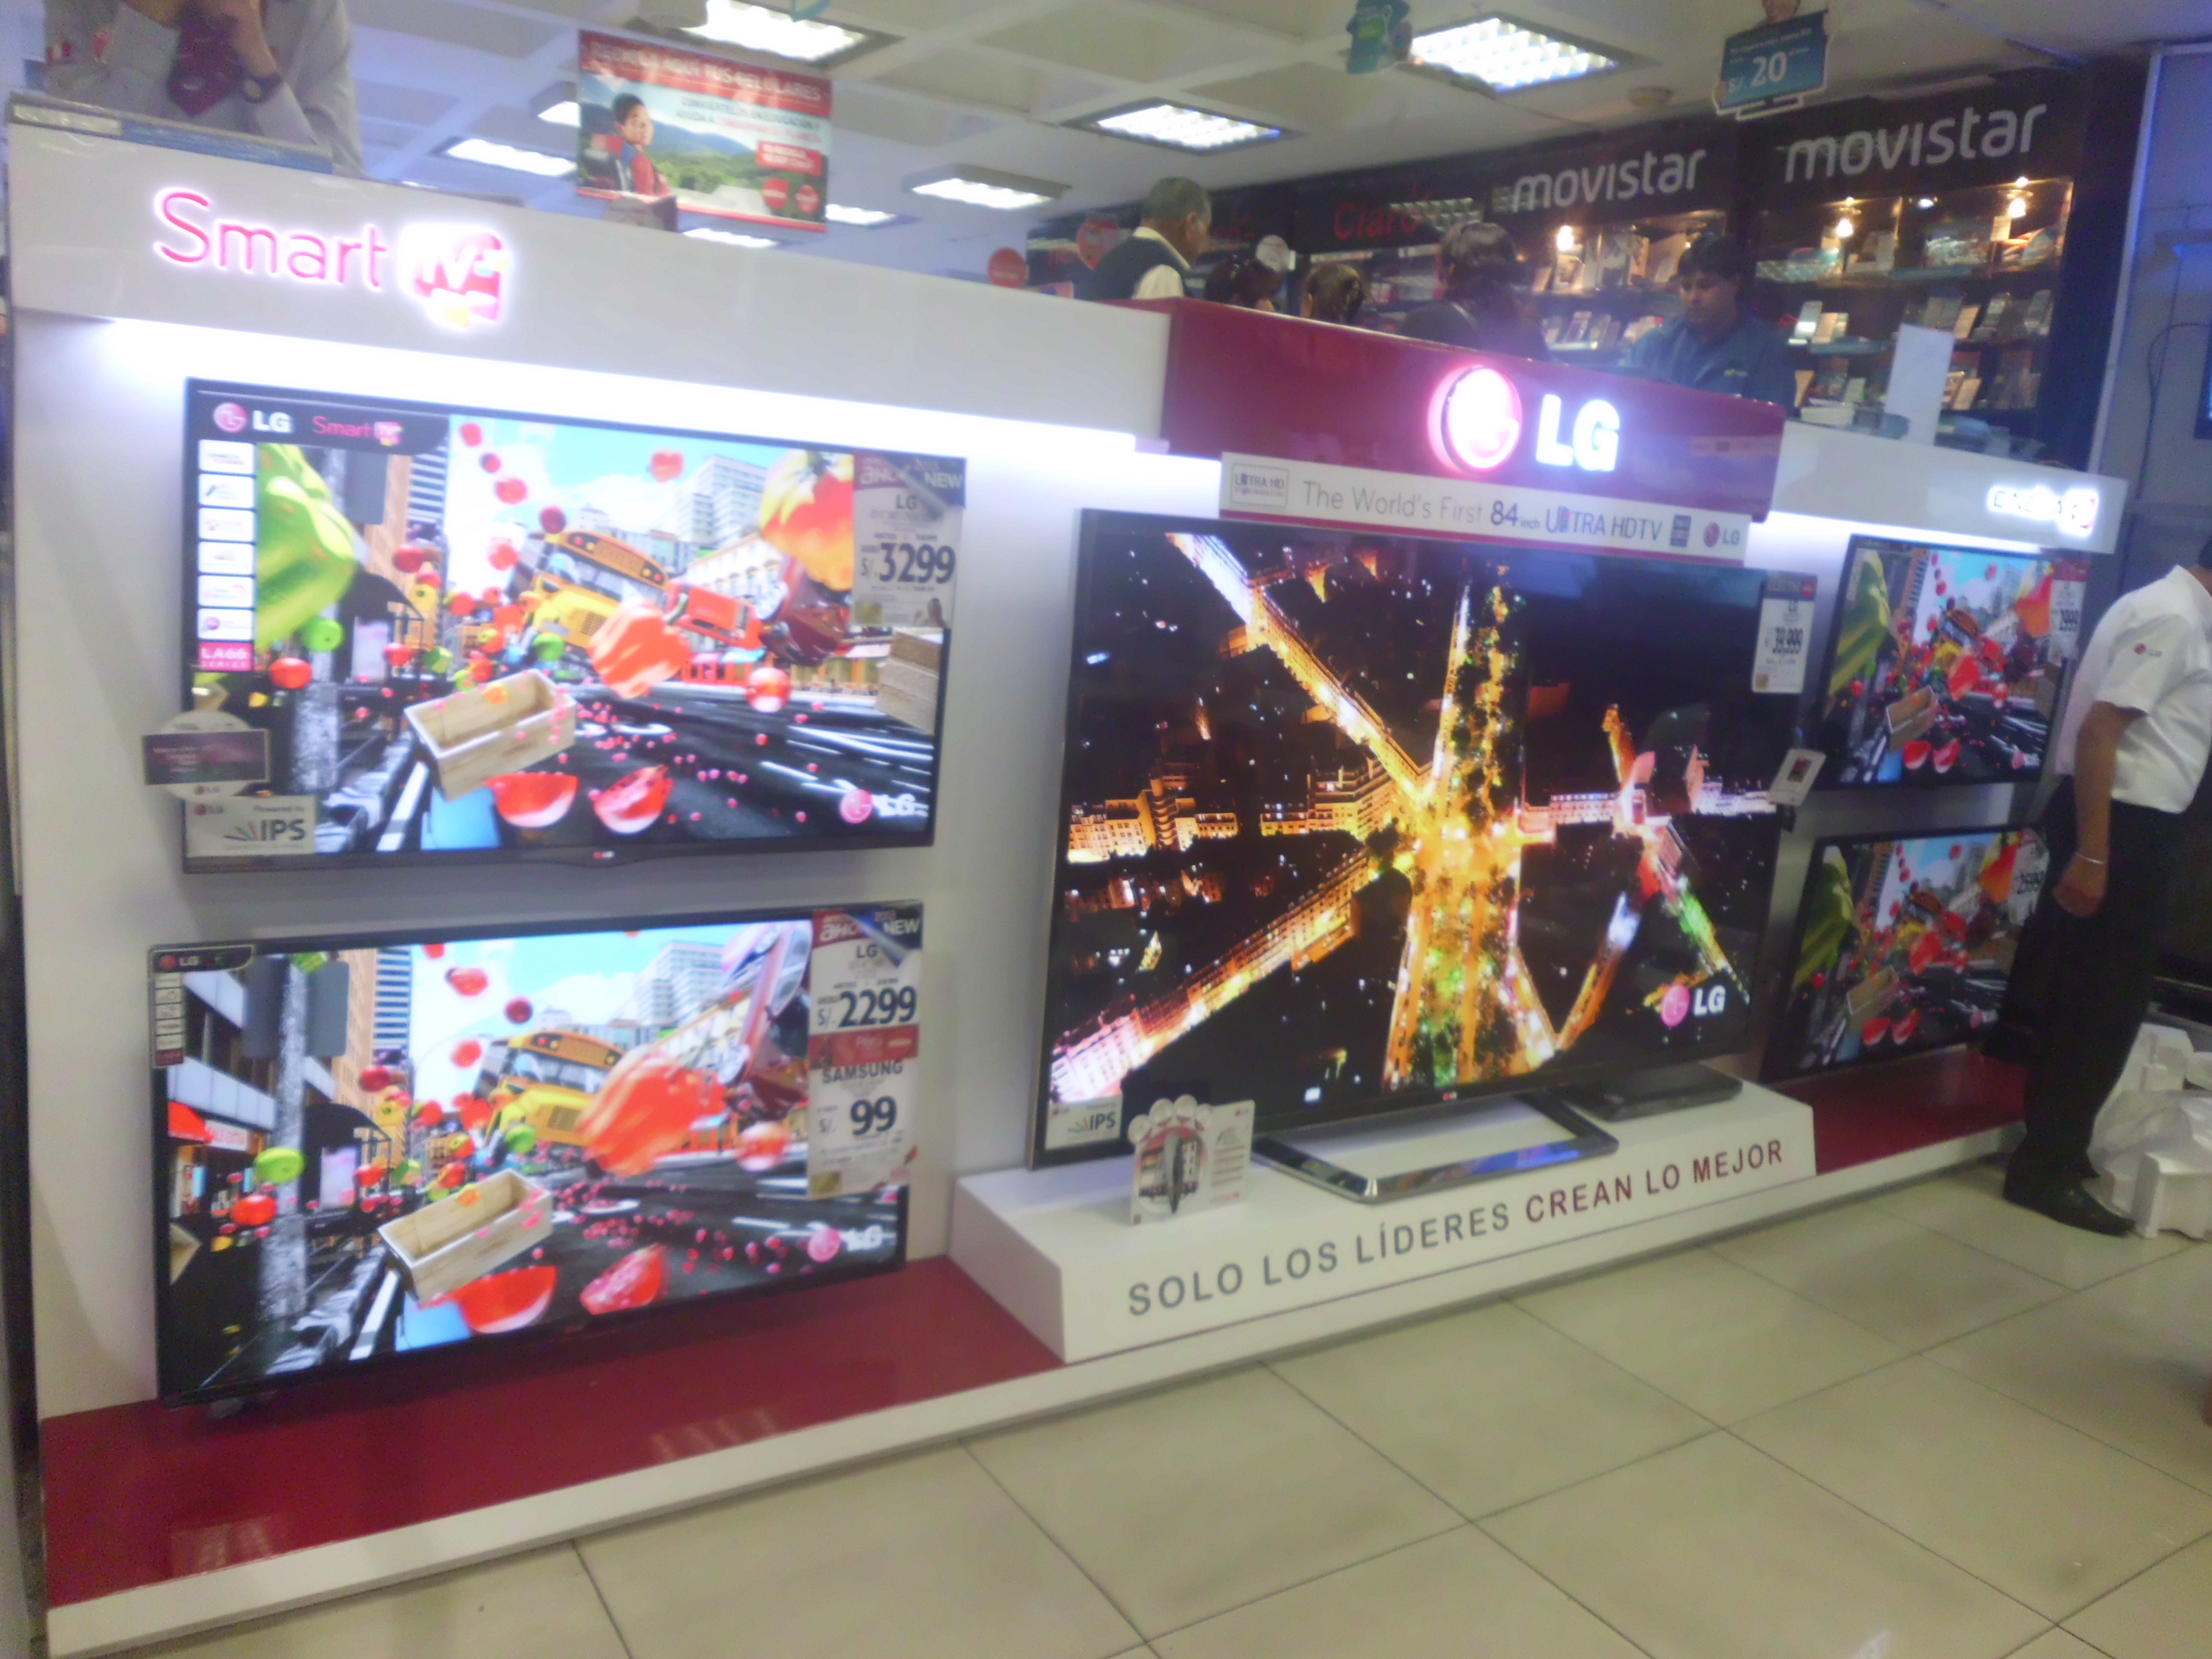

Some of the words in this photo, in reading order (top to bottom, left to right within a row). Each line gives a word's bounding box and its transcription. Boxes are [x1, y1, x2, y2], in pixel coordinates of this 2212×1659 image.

[1751, 51, 1788, 87] 20
[1784, 103, 2047, 183] movistar
[1511, 149, 1706, 212] movistar
[1333, 203, 1420, 240] Claro
[155, 189, 388, 290] Smart
[252, 410, 292, 433] LG
[312, 416, 372, 437] Smart
[1536, 393, 1620, 472] LG
[924, 471, 963, 488] NEW
[1270, 478, 1284, 489] HD
[896, 494, 919, 510] LG
[1303, 480, 1344, 510] The
[1352, 486, 1432, 519] World's
[1440, 496, 1483, 523] First
[1491, 500, 1519, 527] 84
[1521, 516, 1541, 529] inch
[1611, 515, 1664, 541] HDTV
[1722, 528, 1740, 546] LG
[879, 542, 956, 584] 3299
[261, 819, 306, 841] IPS
[883, 918, 920, 935] NEW
[179, 955, 201, 966] LG
[856, 944, 878, 959] LG
[838, 986, 917, 1028] 2299
[1694, 985, 1726, 1016] LG
[822, 1060, 903, 1084] SAMSUNG
[850, 1095, 897, 1136] 99
[1090, 1111, 1116, 1131] IPS
[1129, 1263, 1244, 1316] SOLO
[1263, 1241, 1338, 1286] LOS
[1356, 1203, 1509, 1265] LÍDERES
[1525, 1175, 1634, 1223] CREAN
[1645, 1163, 1681, 1196] LO
[1692, 1139, 1783, 1184] MEJOR
